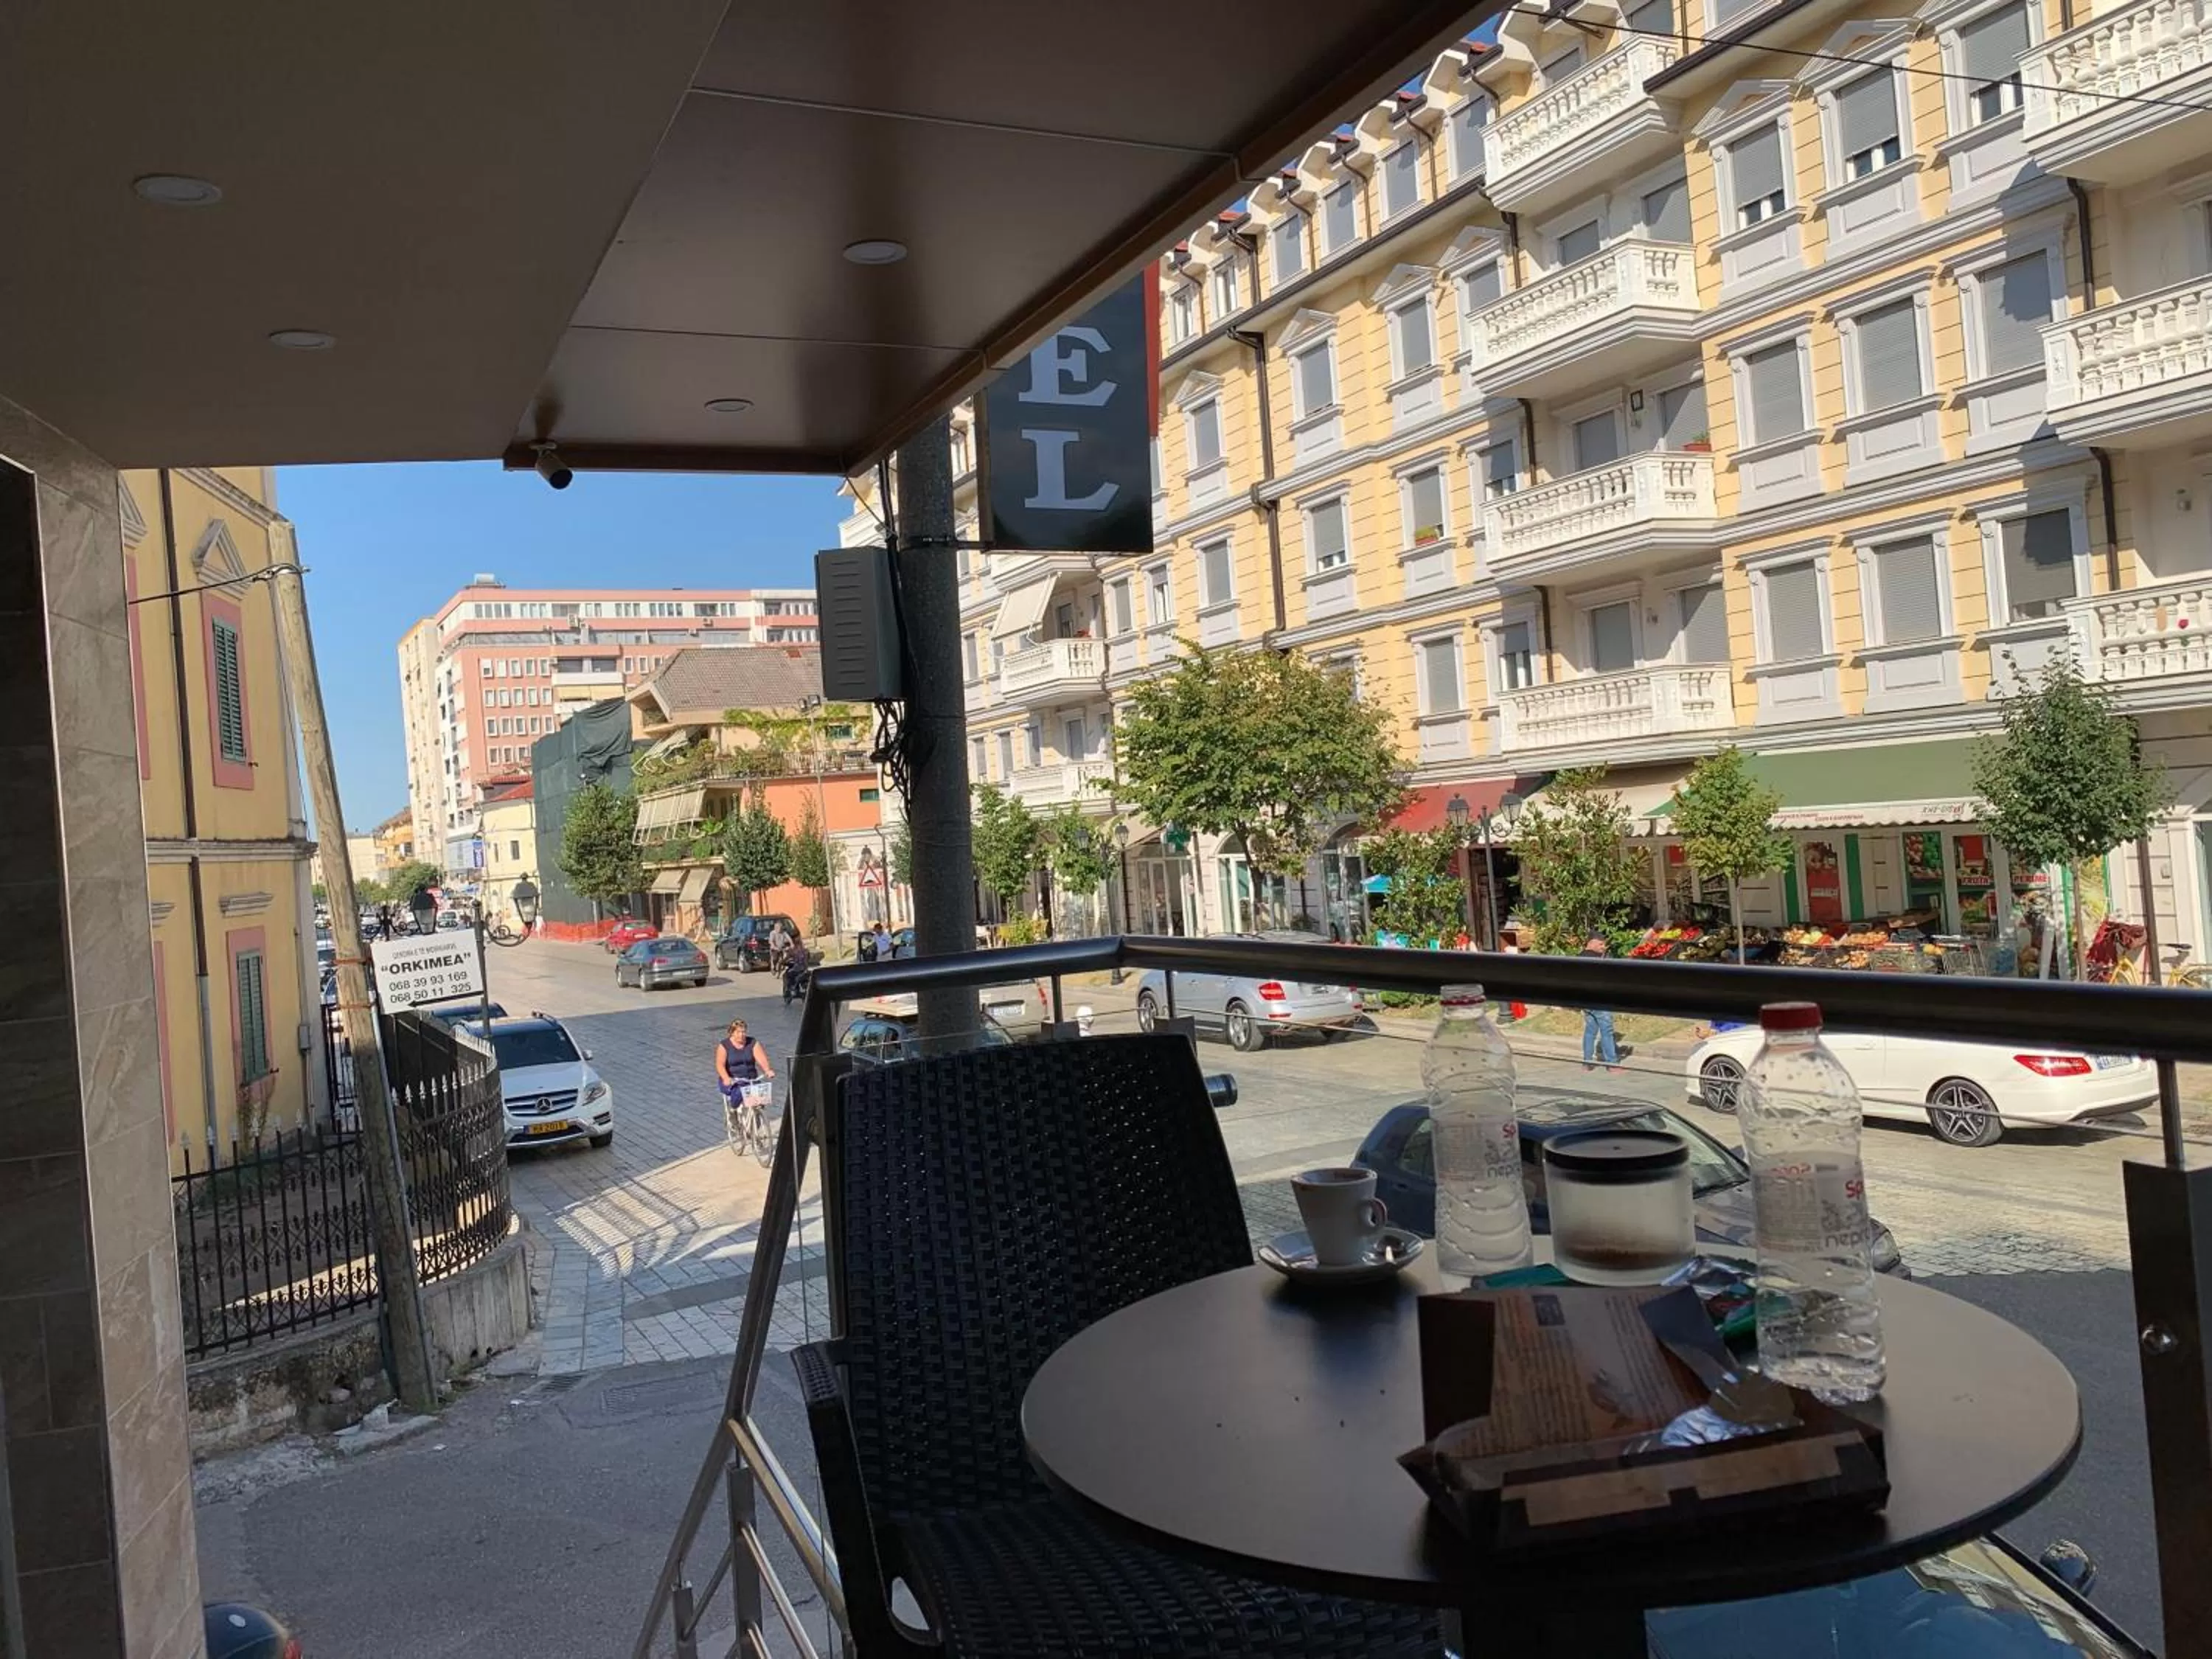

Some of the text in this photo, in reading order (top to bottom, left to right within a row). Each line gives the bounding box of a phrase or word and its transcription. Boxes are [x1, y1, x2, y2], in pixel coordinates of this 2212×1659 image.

[389, 971, 467, 992] 068 39 93 169
[390, 982, 472, 1004] 068 50 11 325
